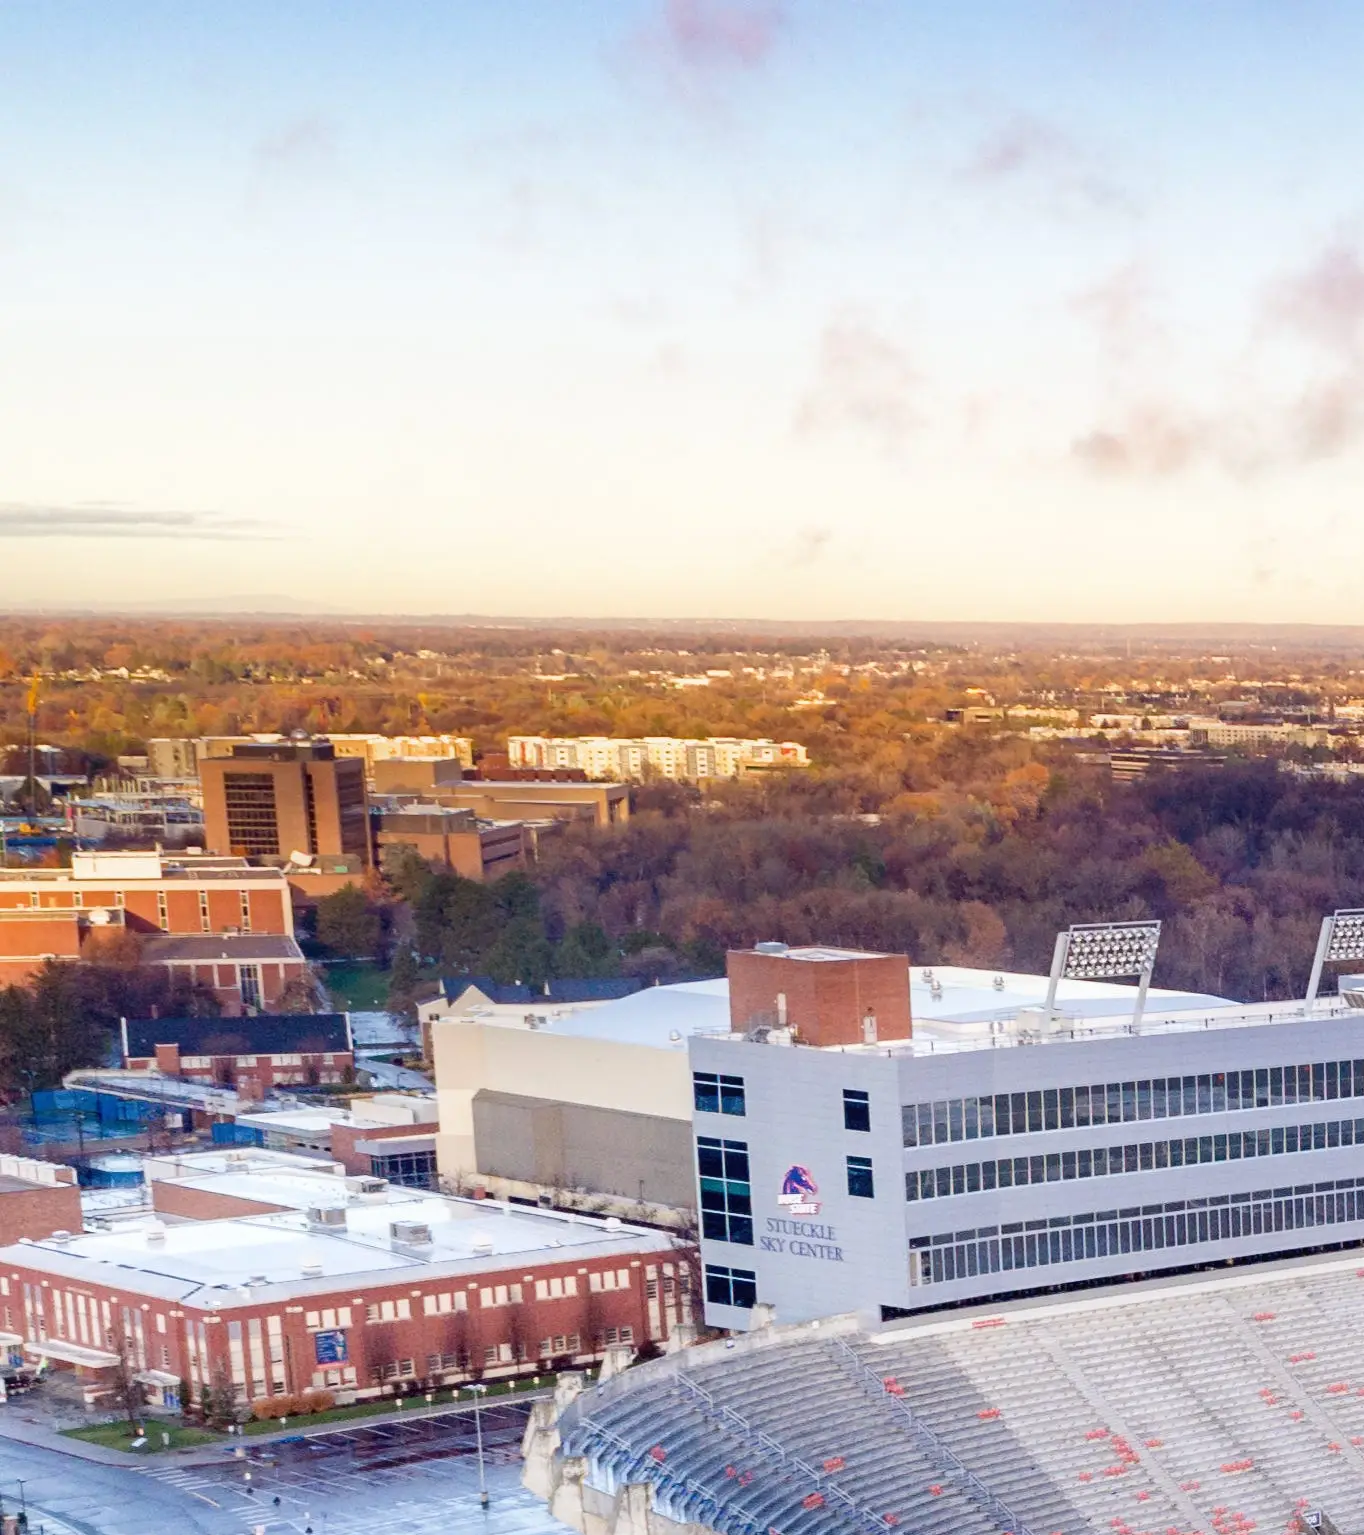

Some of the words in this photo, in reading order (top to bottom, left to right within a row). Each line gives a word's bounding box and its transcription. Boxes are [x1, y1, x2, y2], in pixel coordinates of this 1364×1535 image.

[766, 1217, 836, 1240] STUECKLE
[760, 1236, 786, 1252] SKY
[789, 1240, 844, 1261] CENTER
